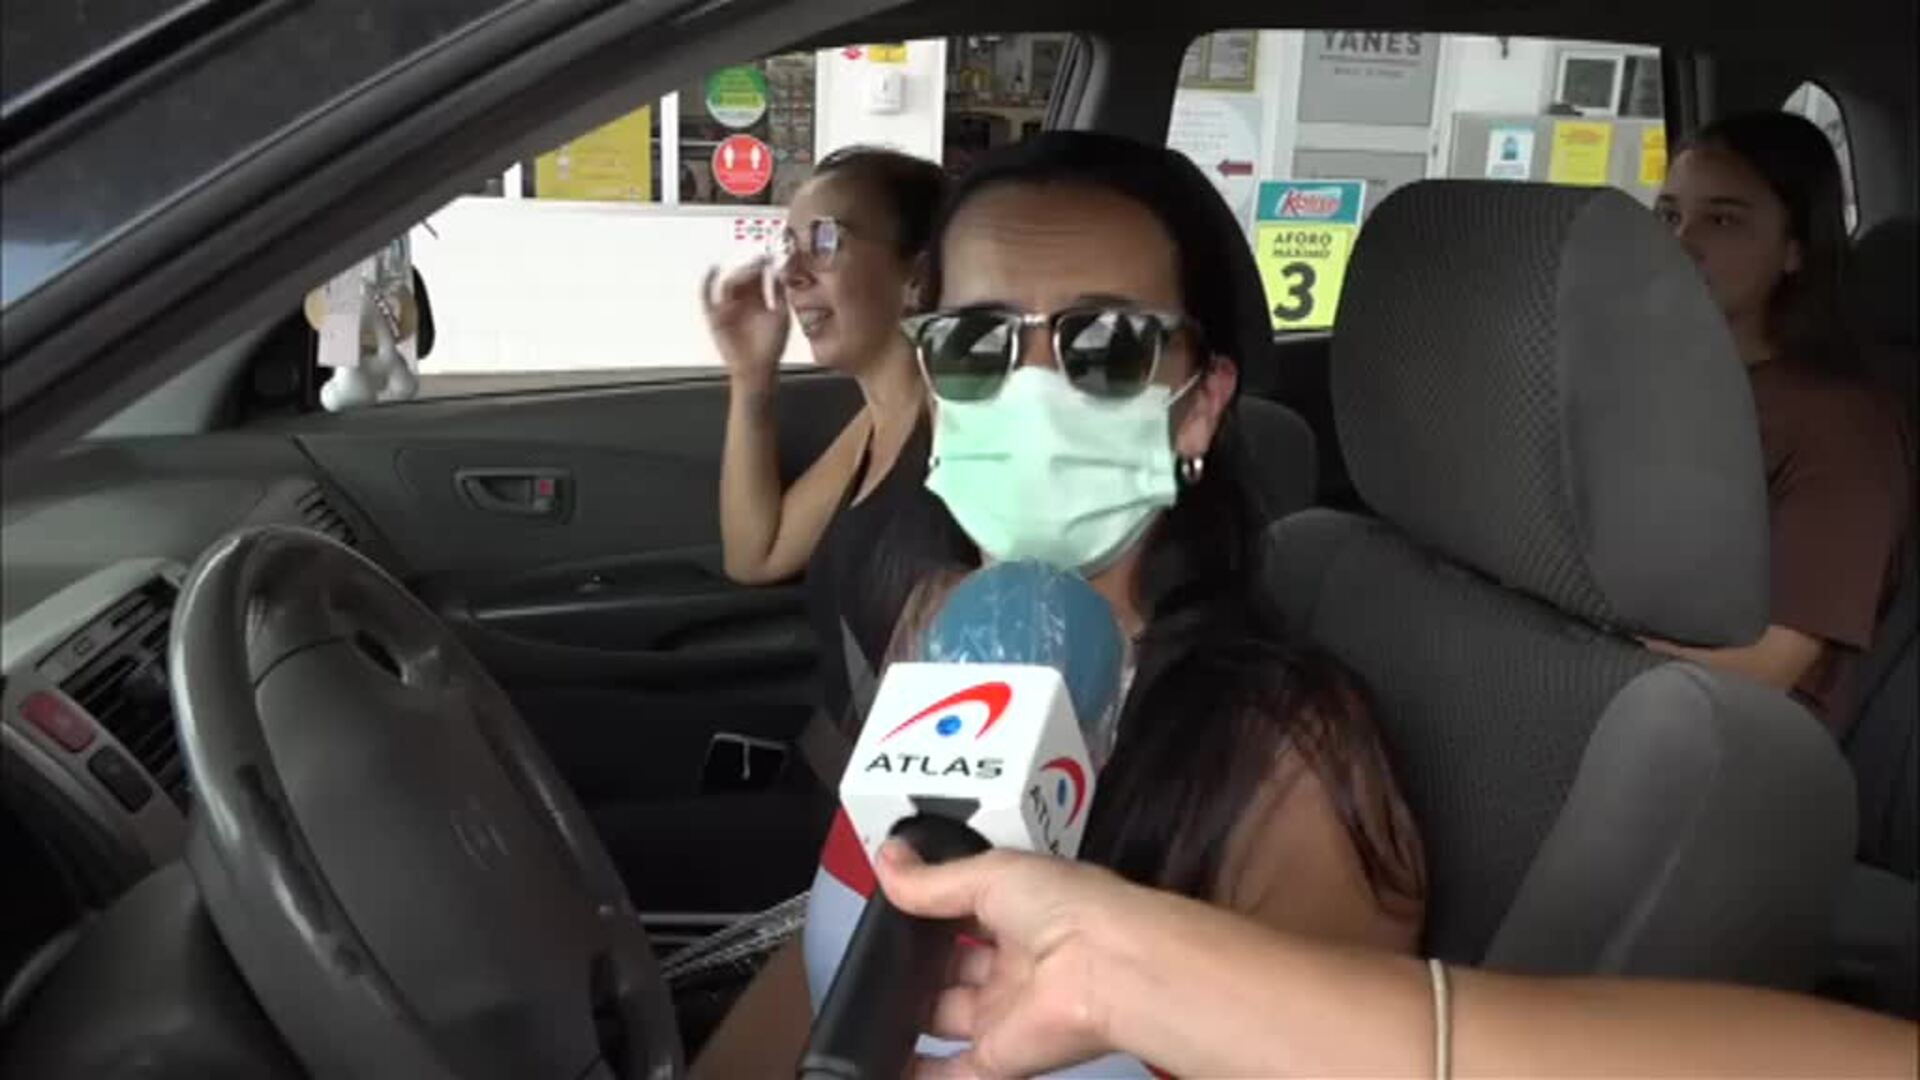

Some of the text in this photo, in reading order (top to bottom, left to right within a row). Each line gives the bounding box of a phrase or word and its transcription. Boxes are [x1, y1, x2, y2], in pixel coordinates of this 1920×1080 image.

[1274, 231, 1332, 247] AFORO
[1273, 261, 1317, 322] 3
[865, 752, 1004, 779] ATLAS
[1028, 784, 1066, 857] ATLA
